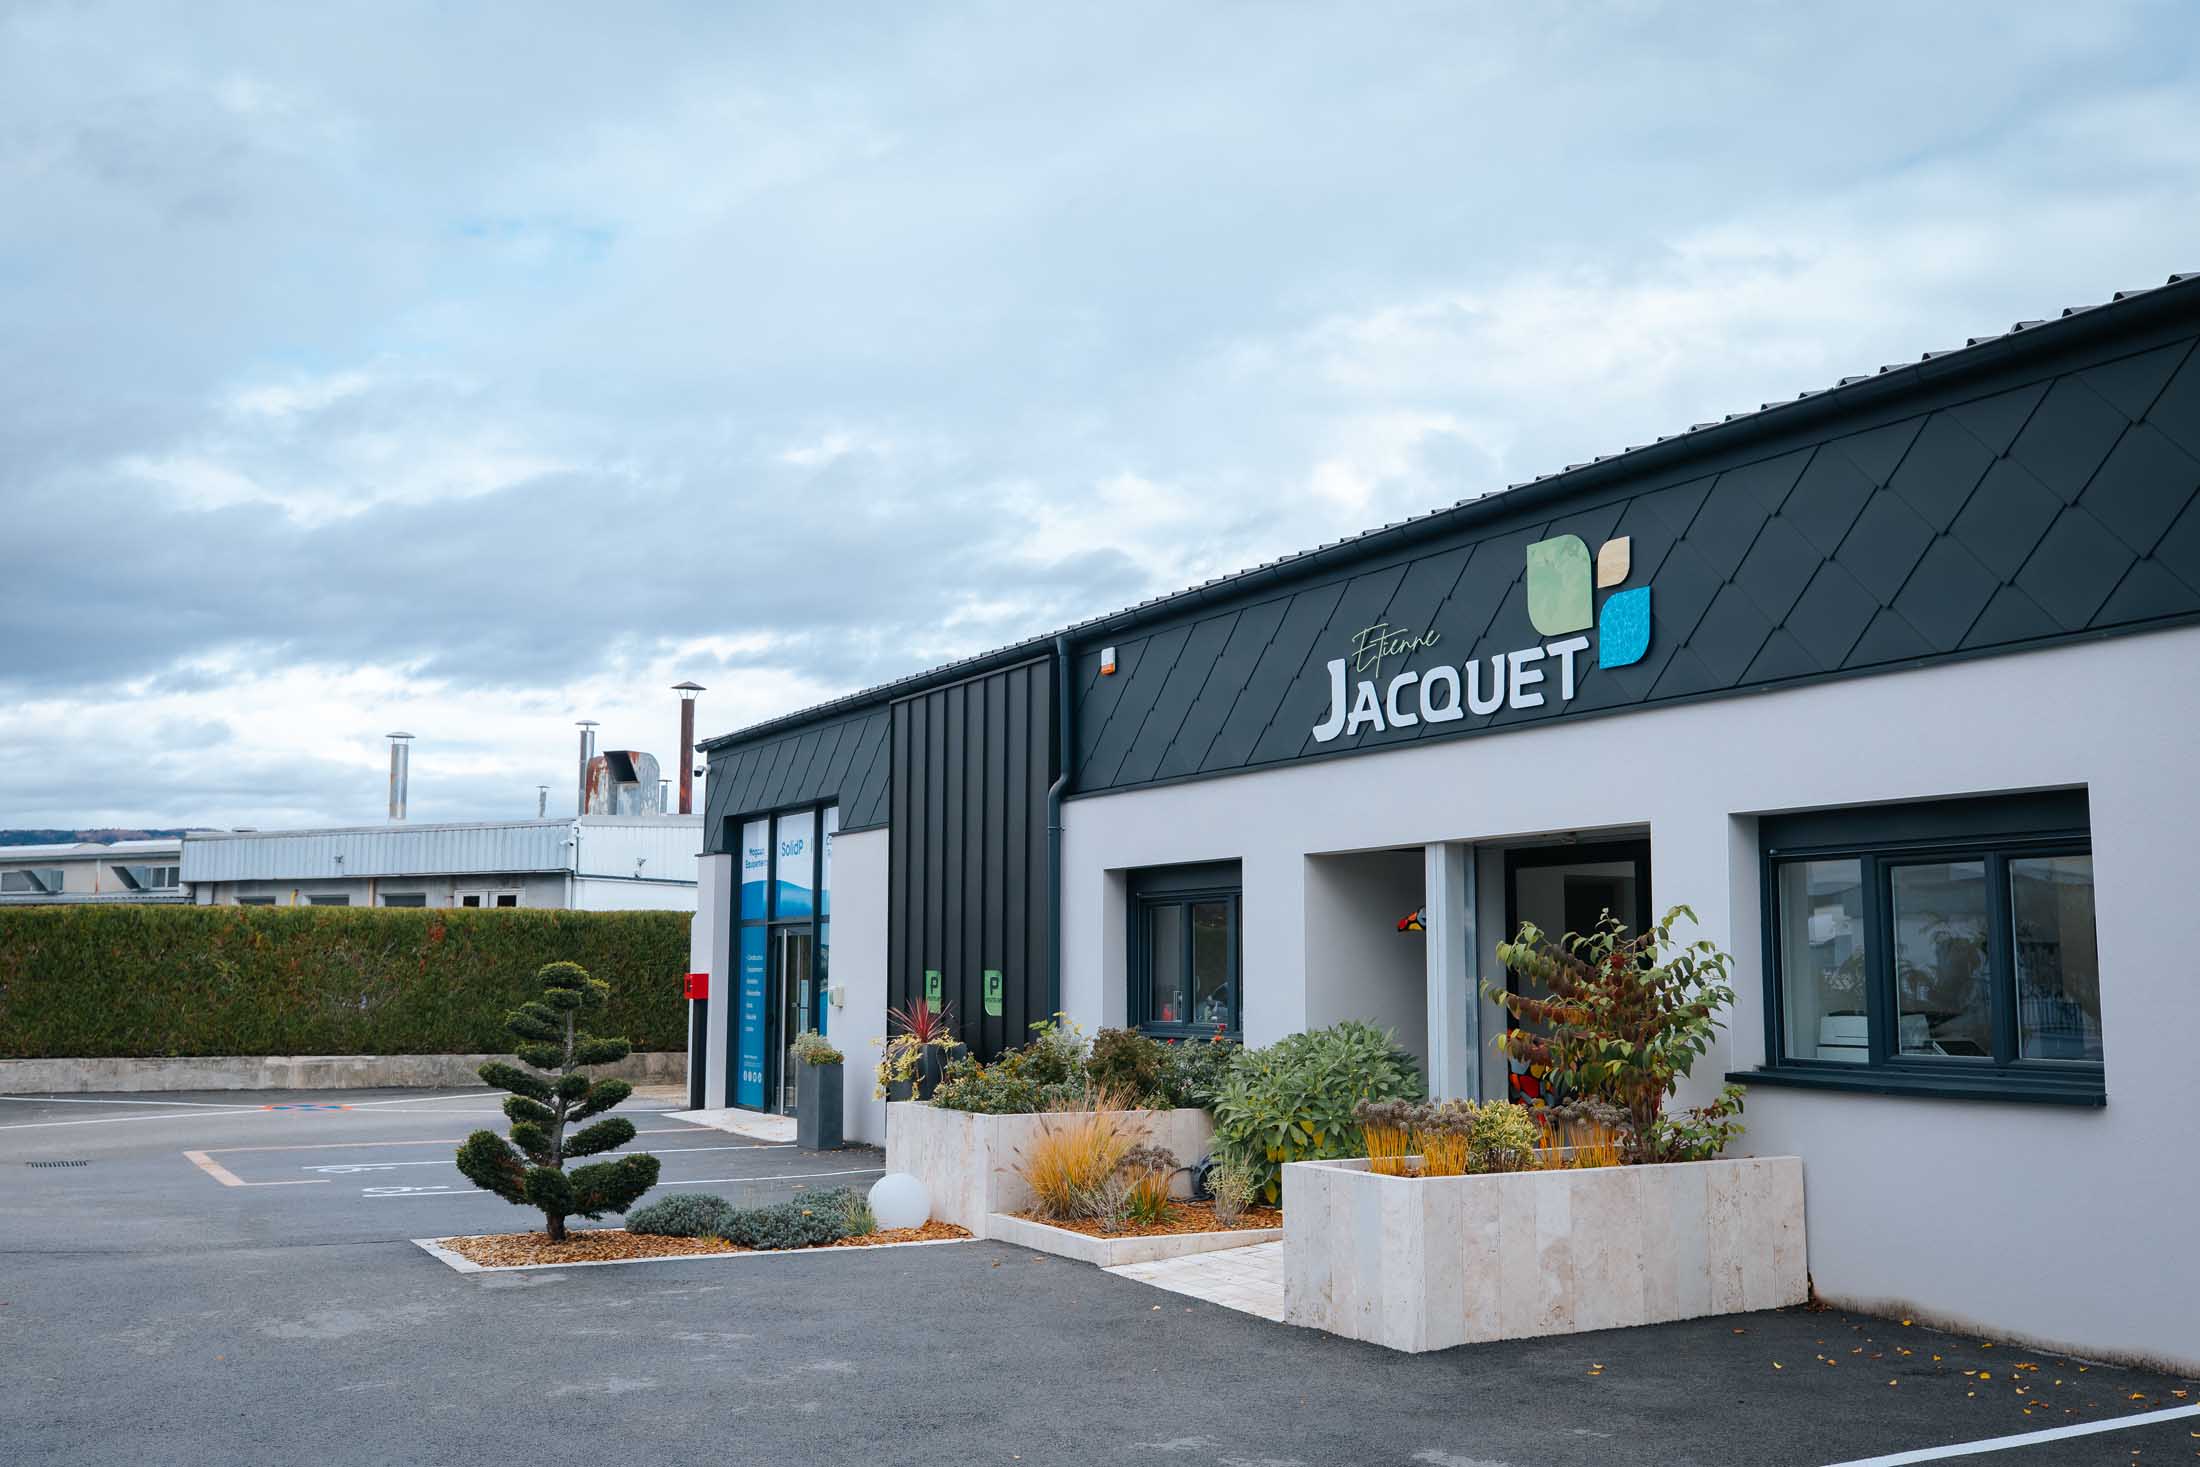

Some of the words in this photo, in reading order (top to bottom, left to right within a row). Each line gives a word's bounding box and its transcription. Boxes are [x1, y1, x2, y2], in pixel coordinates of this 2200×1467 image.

[1351, 623, 1441, 679] Etienne
[1312, 636, 1590, 743] JACQUET
[931, 976, 939, 995] P
[990, 976, 999, 996] P
